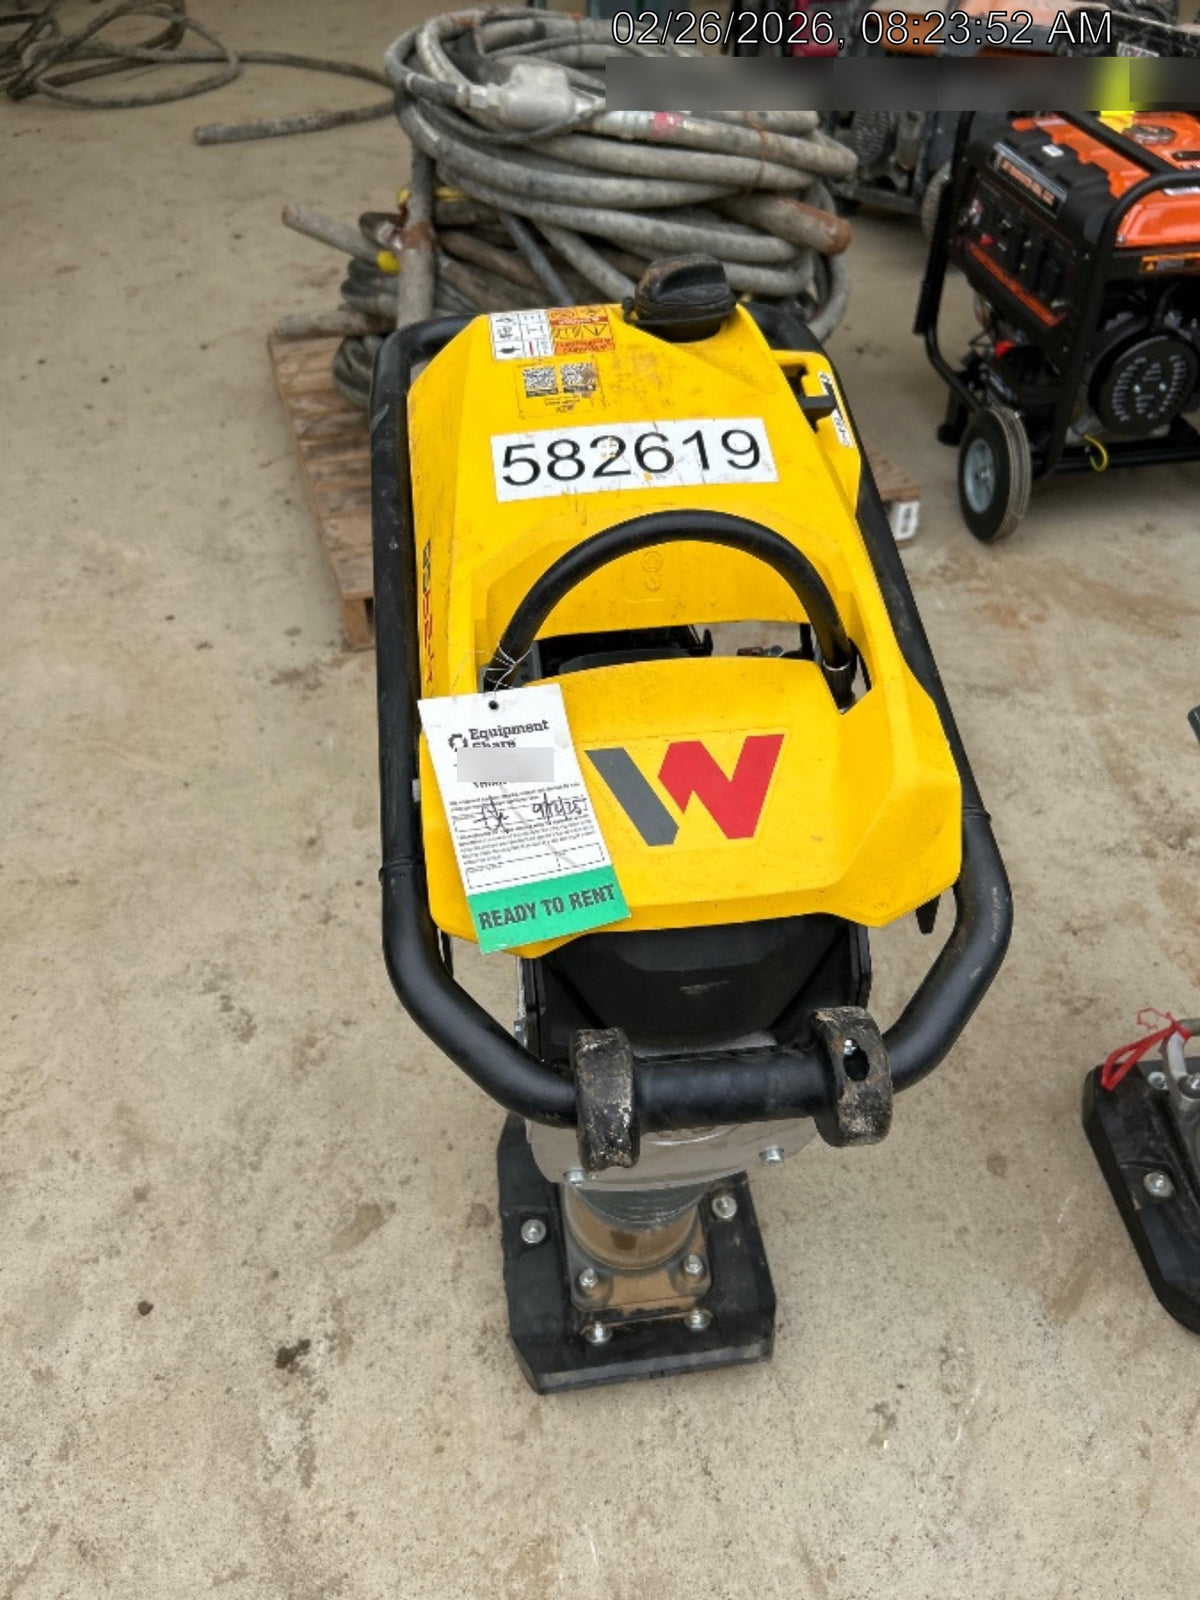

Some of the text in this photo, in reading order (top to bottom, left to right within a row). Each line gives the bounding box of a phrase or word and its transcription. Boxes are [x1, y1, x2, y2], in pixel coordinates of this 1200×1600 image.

[501, 428, 762, 487] 582619
[468, 719, 550, 741] Equipment
[478, 884, 616, 931] READY TO RENT
